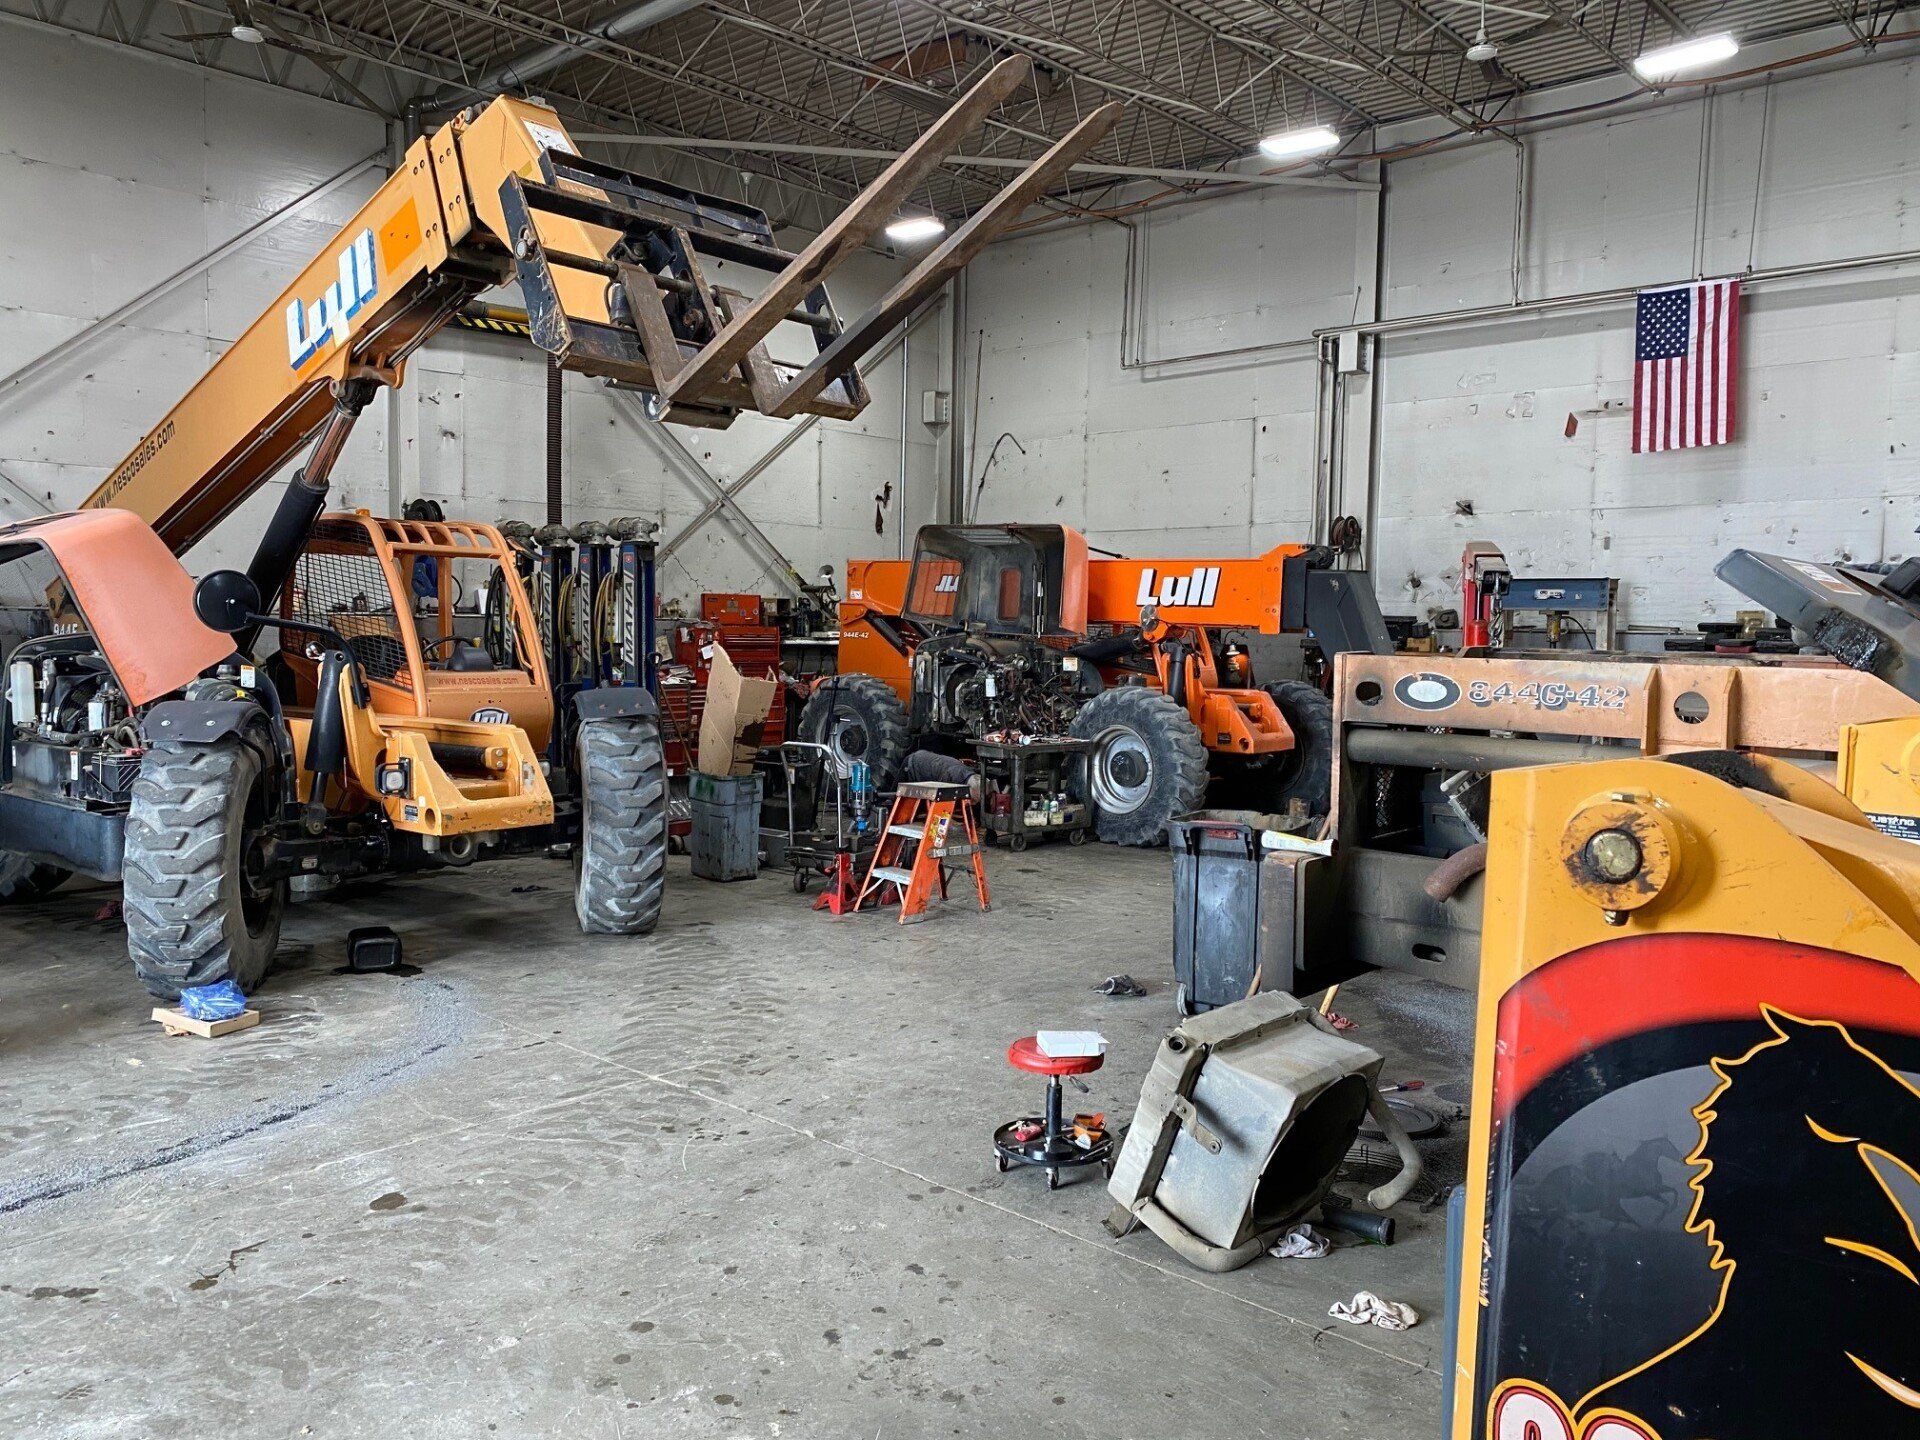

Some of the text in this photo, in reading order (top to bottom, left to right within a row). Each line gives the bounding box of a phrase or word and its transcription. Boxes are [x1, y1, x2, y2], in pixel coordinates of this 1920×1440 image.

[287, 228, 378, 371] Lull
[582, 582, 591, 659] MAHA
[625, 582, 634, 663] MAHA
[1136, 567, 1221, 607] Lull
[436, 676, 519, 685] www.nescosales.com
